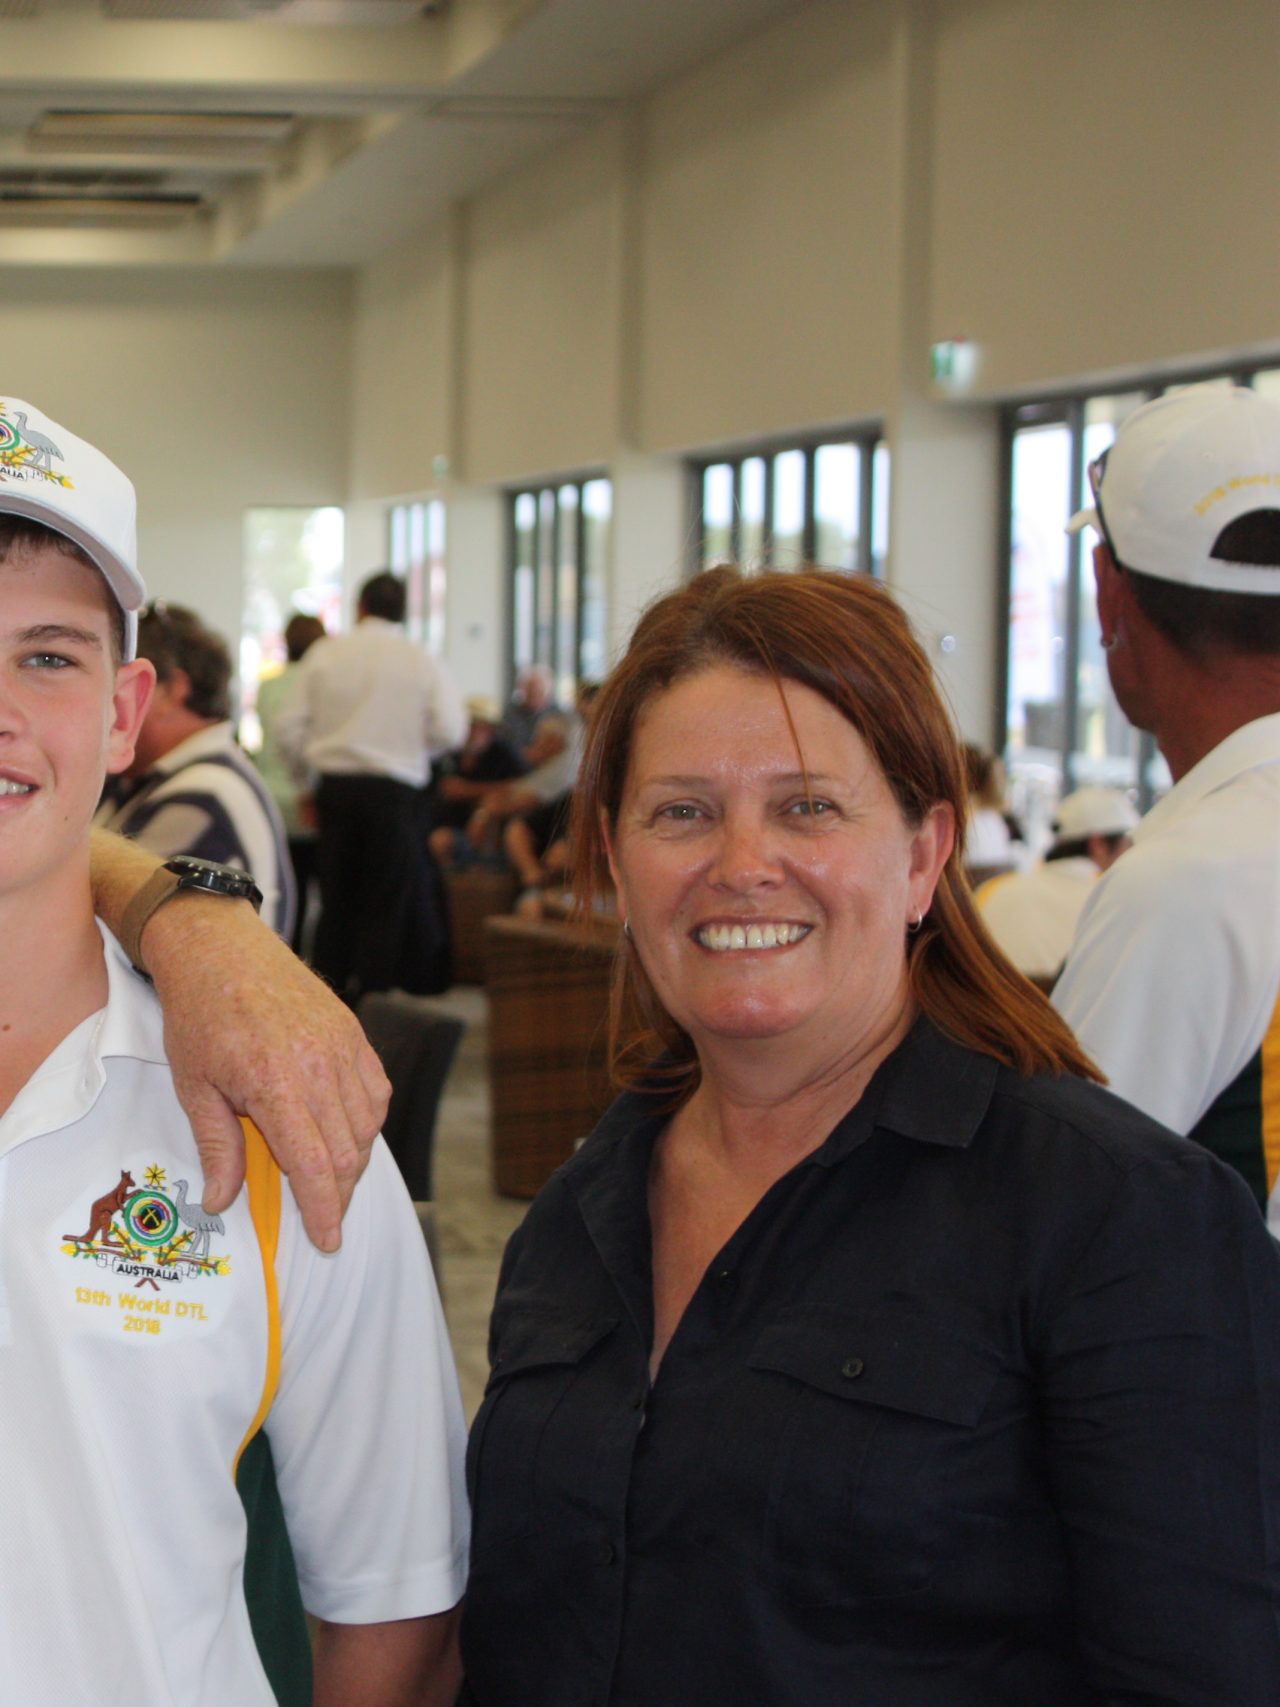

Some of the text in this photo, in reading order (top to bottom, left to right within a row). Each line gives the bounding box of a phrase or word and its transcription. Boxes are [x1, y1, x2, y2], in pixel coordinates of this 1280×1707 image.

[117, 1264, 179, 1281] AUSTRALIA
[76, 1287, 208, 1321] 13th World DTL
[123, 1314, 161, 1335] 2018
